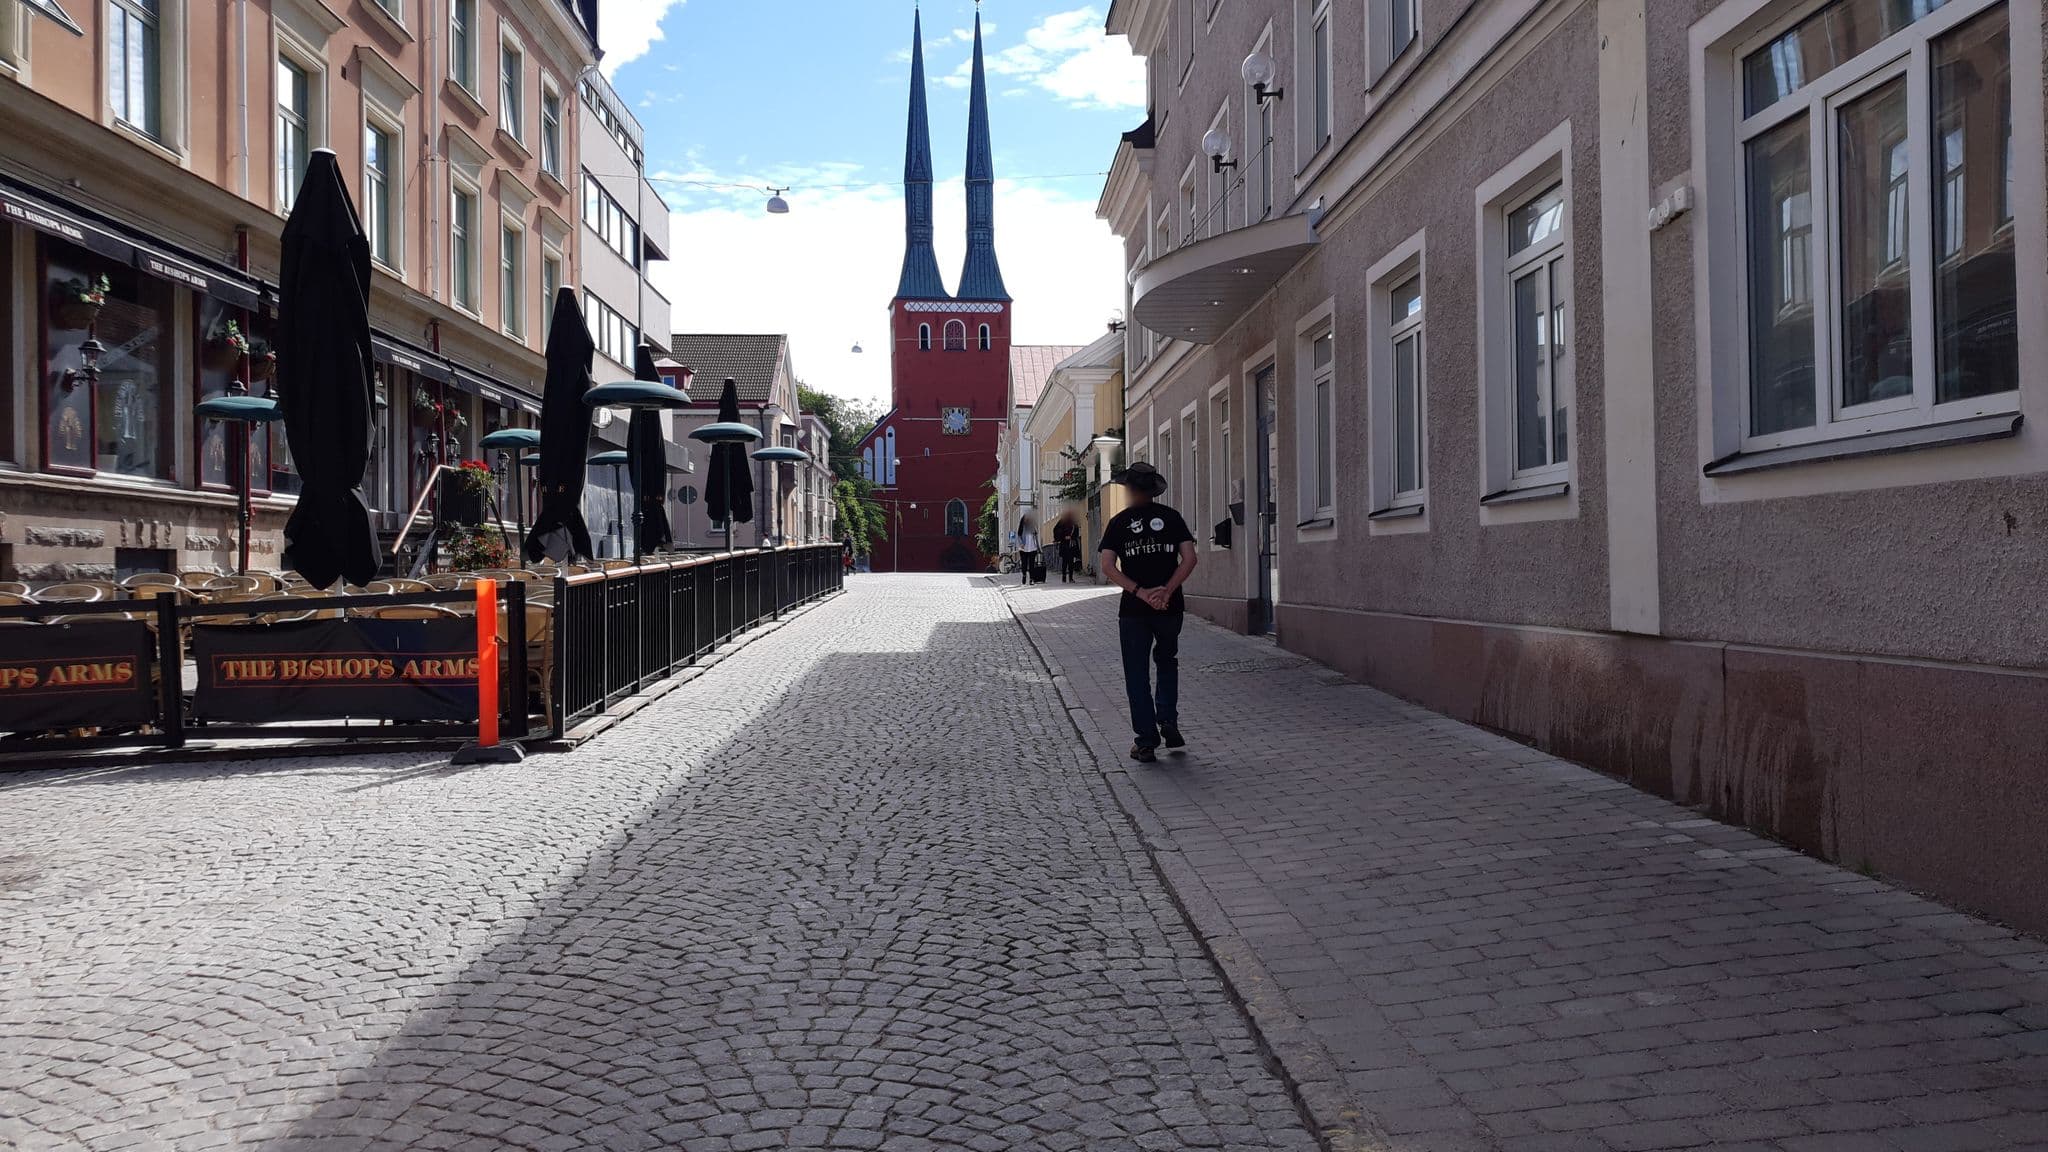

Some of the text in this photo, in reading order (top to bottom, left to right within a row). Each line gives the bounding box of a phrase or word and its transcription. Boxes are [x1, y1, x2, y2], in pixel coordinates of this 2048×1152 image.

[3, 202, 25, 218] THE
[1125, 544, 1162, 557] HOTTEST
[0, 662, 134, 689] PS ARMS
[221, 657, 479, 681] THE BISHOPS ARMS
